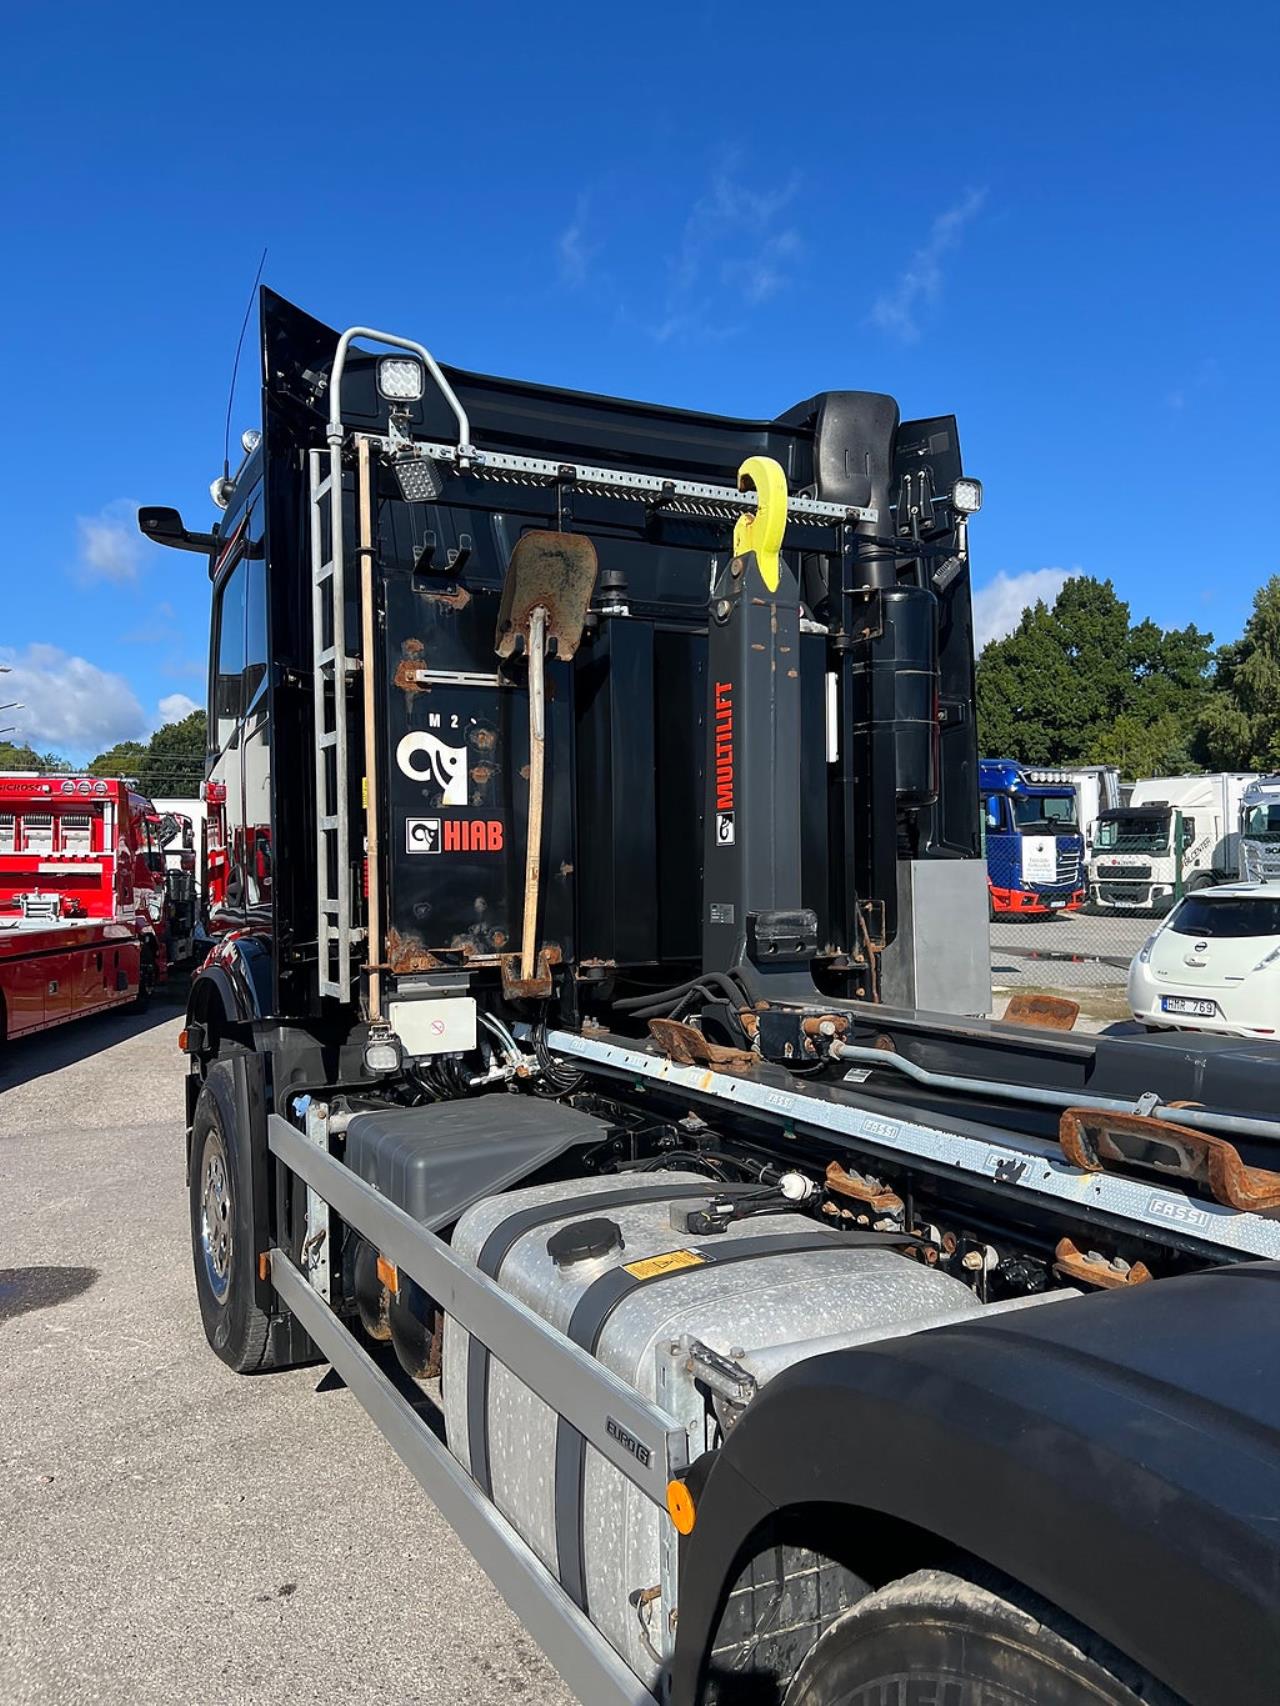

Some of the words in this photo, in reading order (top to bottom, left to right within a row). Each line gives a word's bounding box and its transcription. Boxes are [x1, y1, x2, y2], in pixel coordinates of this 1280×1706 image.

[715, 682, 734, 810] MULTILIFT
[444, 820, 503, 851] HIAB
[1168, 998, 1186, 1010] HMR
[1193, 1001, 1213, 1013] 769
[1150, 1199, 1209, 1227] FASSI
